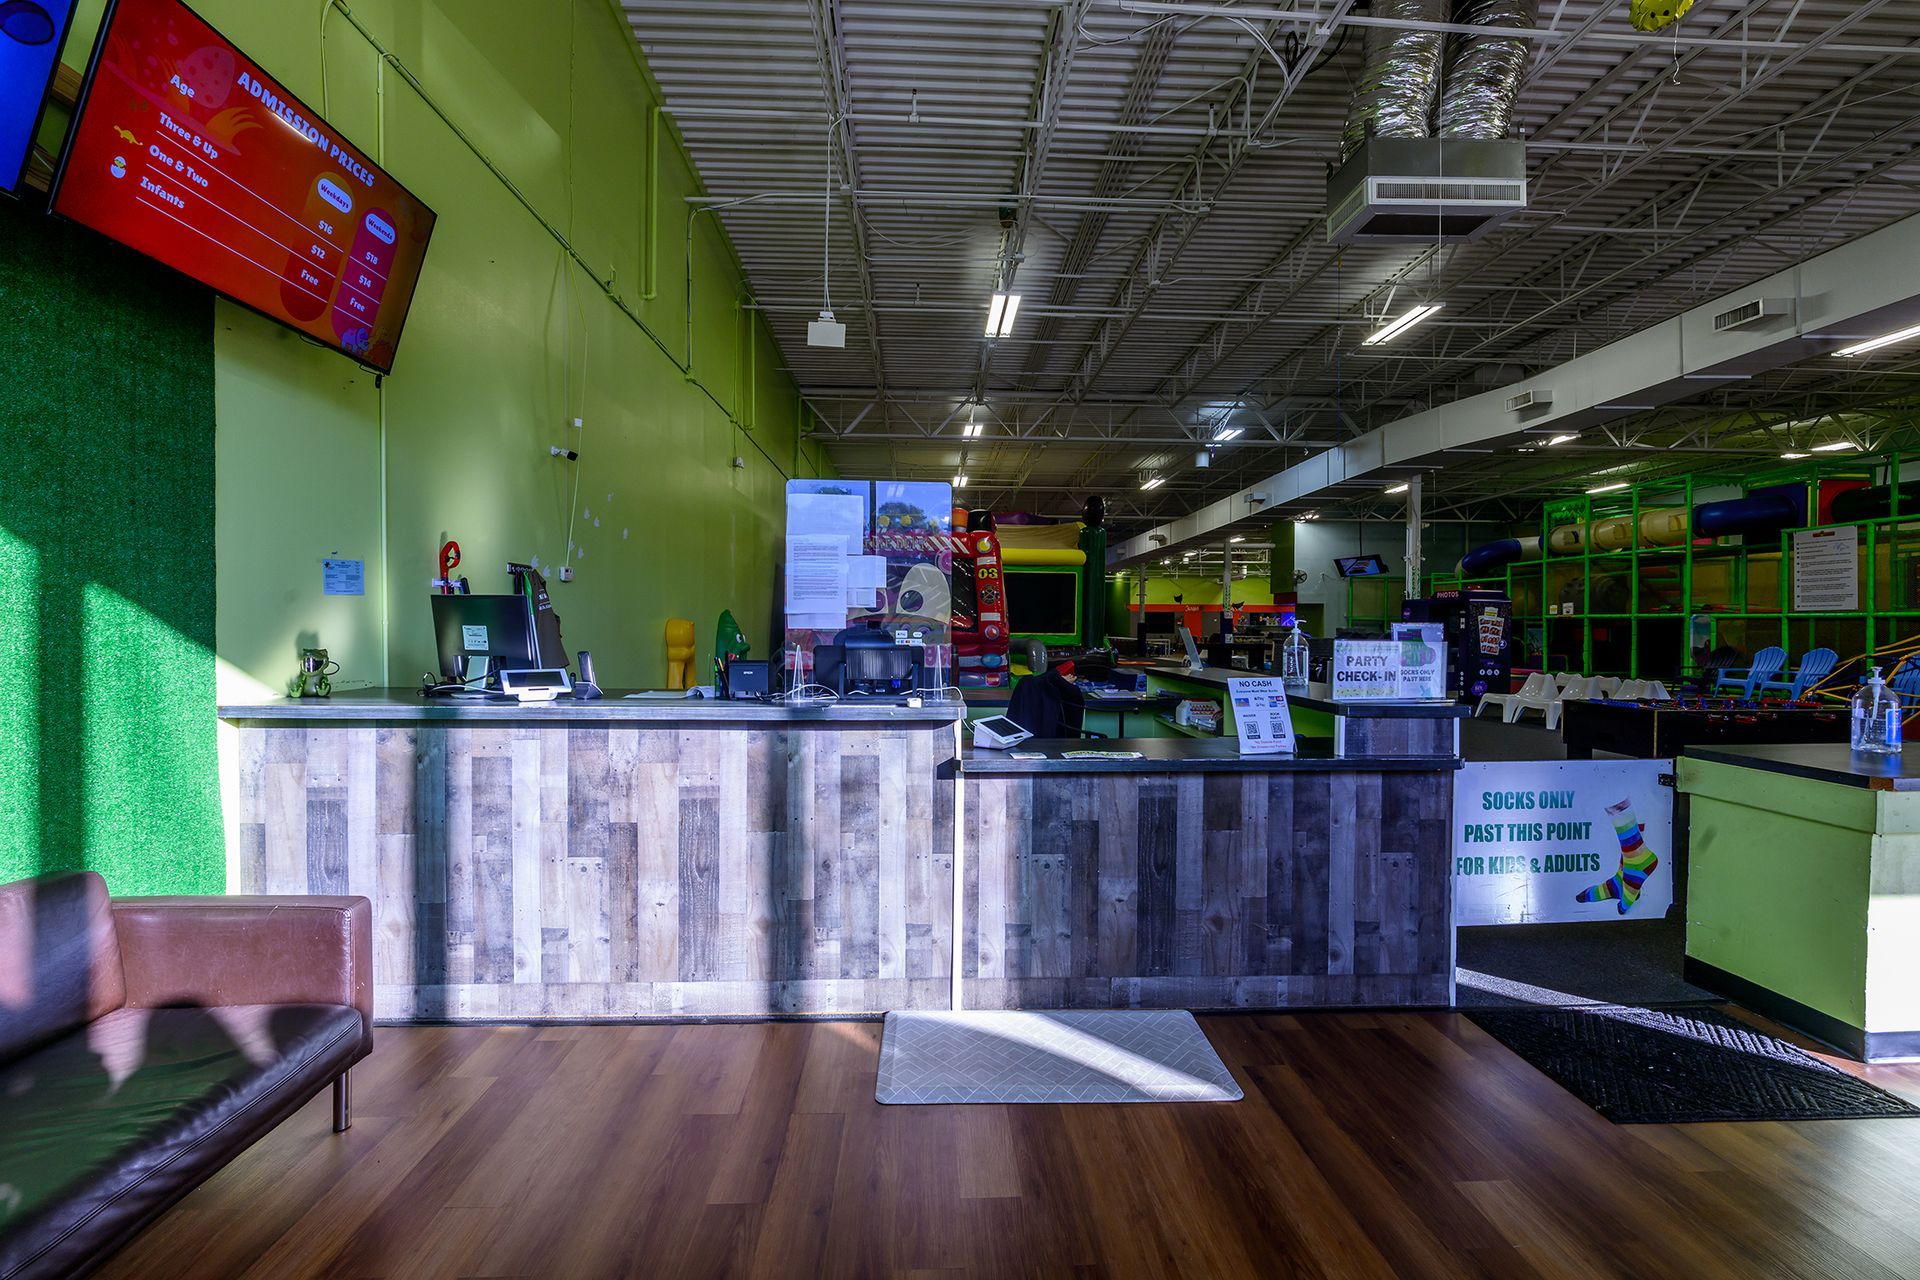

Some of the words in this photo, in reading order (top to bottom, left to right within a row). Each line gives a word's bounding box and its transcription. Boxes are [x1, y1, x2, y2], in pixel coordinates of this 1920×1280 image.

[170, 74, 196, 98] Age
[160, 112, 191, 141] Three
[192, 135, 201, 147] &
[203, 142, 218, 159] Up
[237, 72, 329, 152] ADMISSION
[330, 144, 375, 187] PRICES
[149, 145, 173, 166] One
[175, 160, 184, 171] &
[187, 166, 208, 187] Two
[140, 176, 185, 209] Infants
[320, 184, 349, 209] Weekdays
[318, 220, 333, 235] $16
[368, 218, 393, 240] Weekends
[311, 244, 326, 259] $12
[365, 252, 378, 265] $18
[301, 269, 319, 286] Free
[359, 275, 372, 288] $14
[349, 297, 366, 312] Free
[978, 567, 998, 579] 03
[1346, 656, 1389, 667] PARTY
[1482, 791, 1535, 810] SOCKS
[1539, 790, 1575, 809] ONLY
[1464, 824, 1504, 843] PAST
[1508, 823, 1542, 842] THIS
[1546, 821, 1592, 841] POINT
[1456, 856, 1484, 876] FOR
[1488, 855, 1526, 875] KIDS
[1530, 858, 1541, 873] &
[1544, 853, 1600, 873] ADULTS
